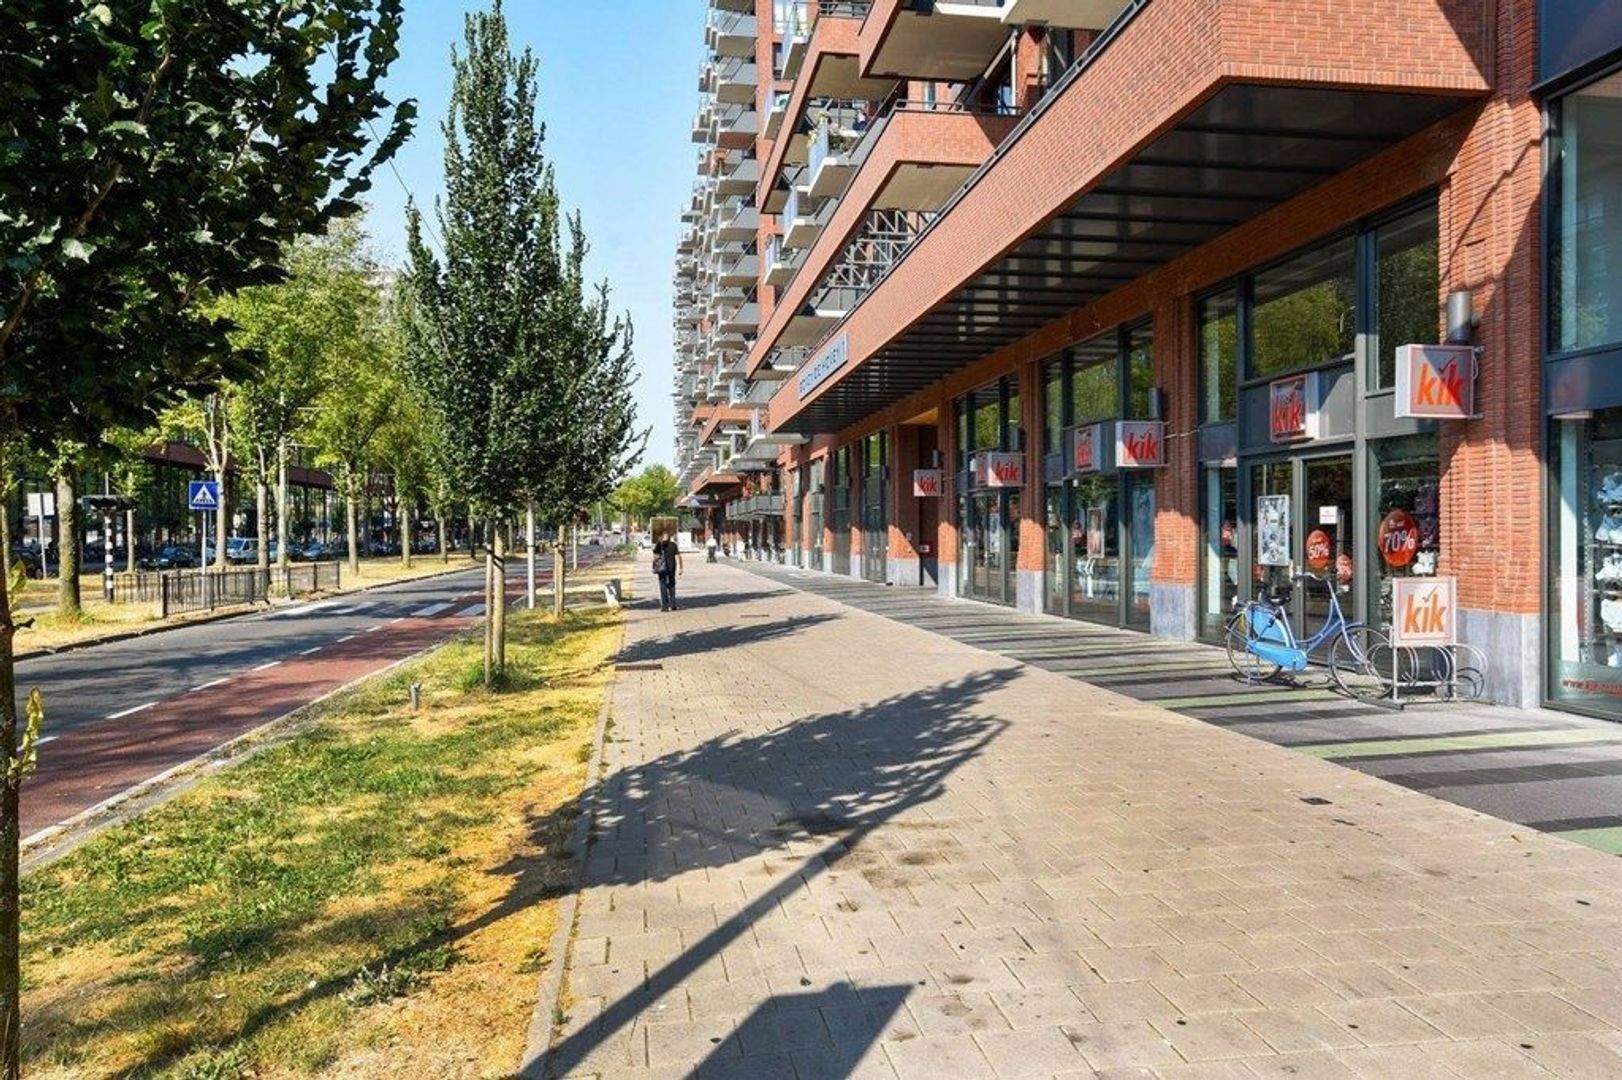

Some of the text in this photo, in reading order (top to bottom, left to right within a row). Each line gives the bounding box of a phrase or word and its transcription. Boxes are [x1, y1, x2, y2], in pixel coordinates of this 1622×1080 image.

[1307, 543, 1330, 561] 50%
[1384, 530, 1416, 553] 70%
[1404, 586, 1447, 633] kik
